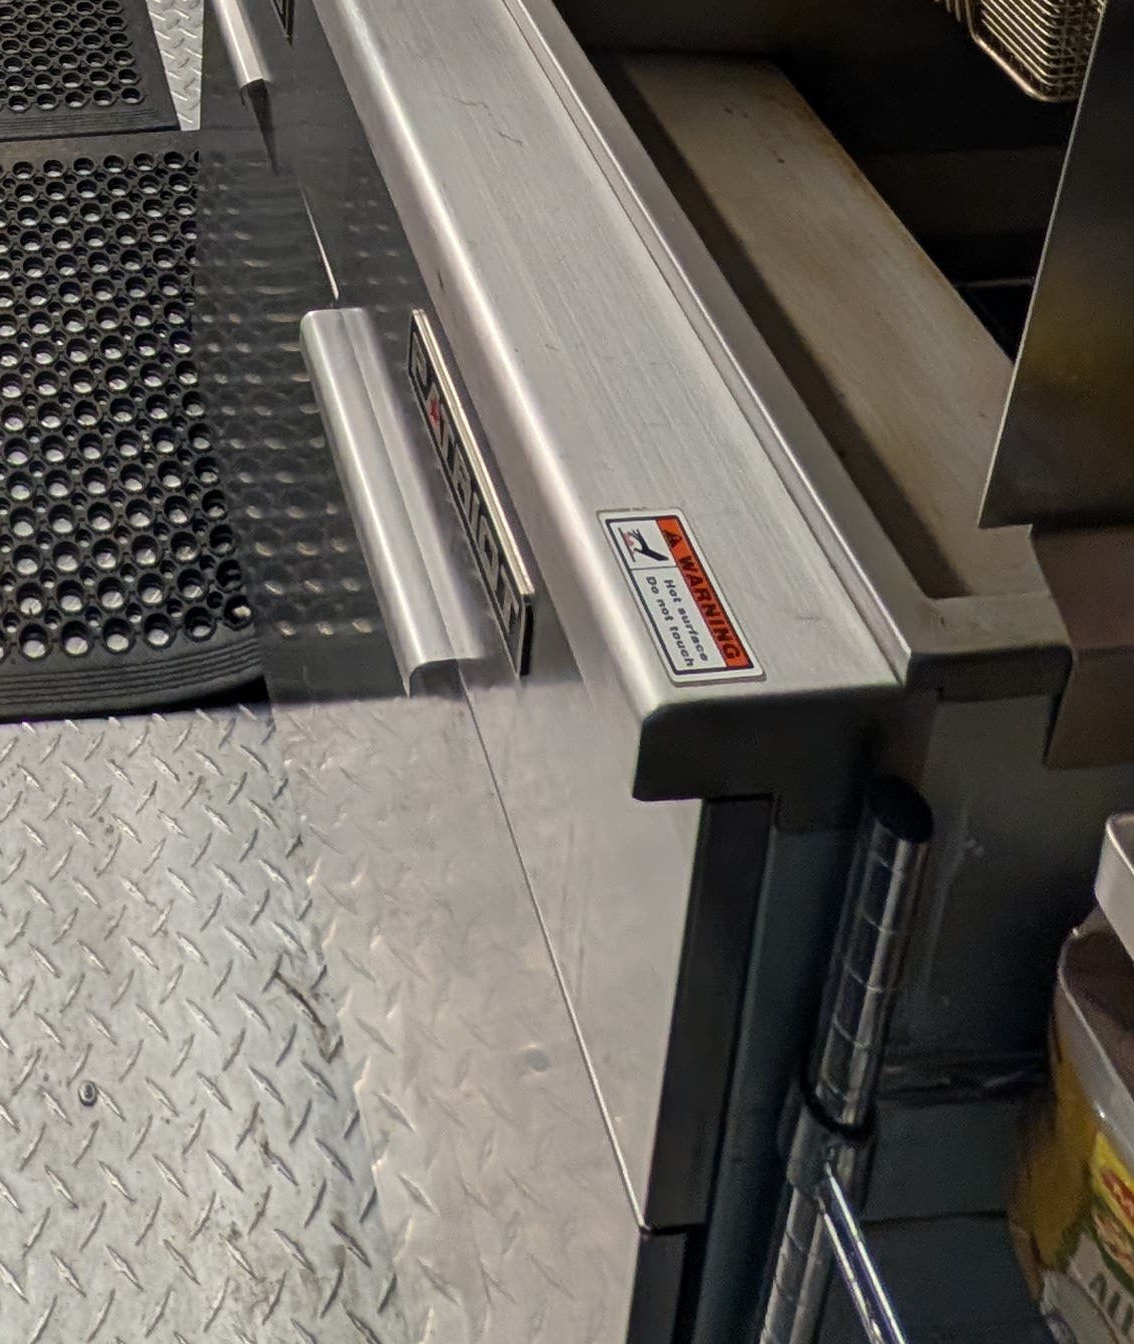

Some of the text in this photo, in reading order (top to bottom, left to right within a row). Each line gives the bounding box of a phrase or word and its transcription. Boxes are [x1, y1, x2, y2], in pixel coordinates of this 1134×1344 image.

[646, 576, 694, 667] Do not touch
[664, 578, 708, 662] Hot surface
[678, 555, 742, 659] WARNING
